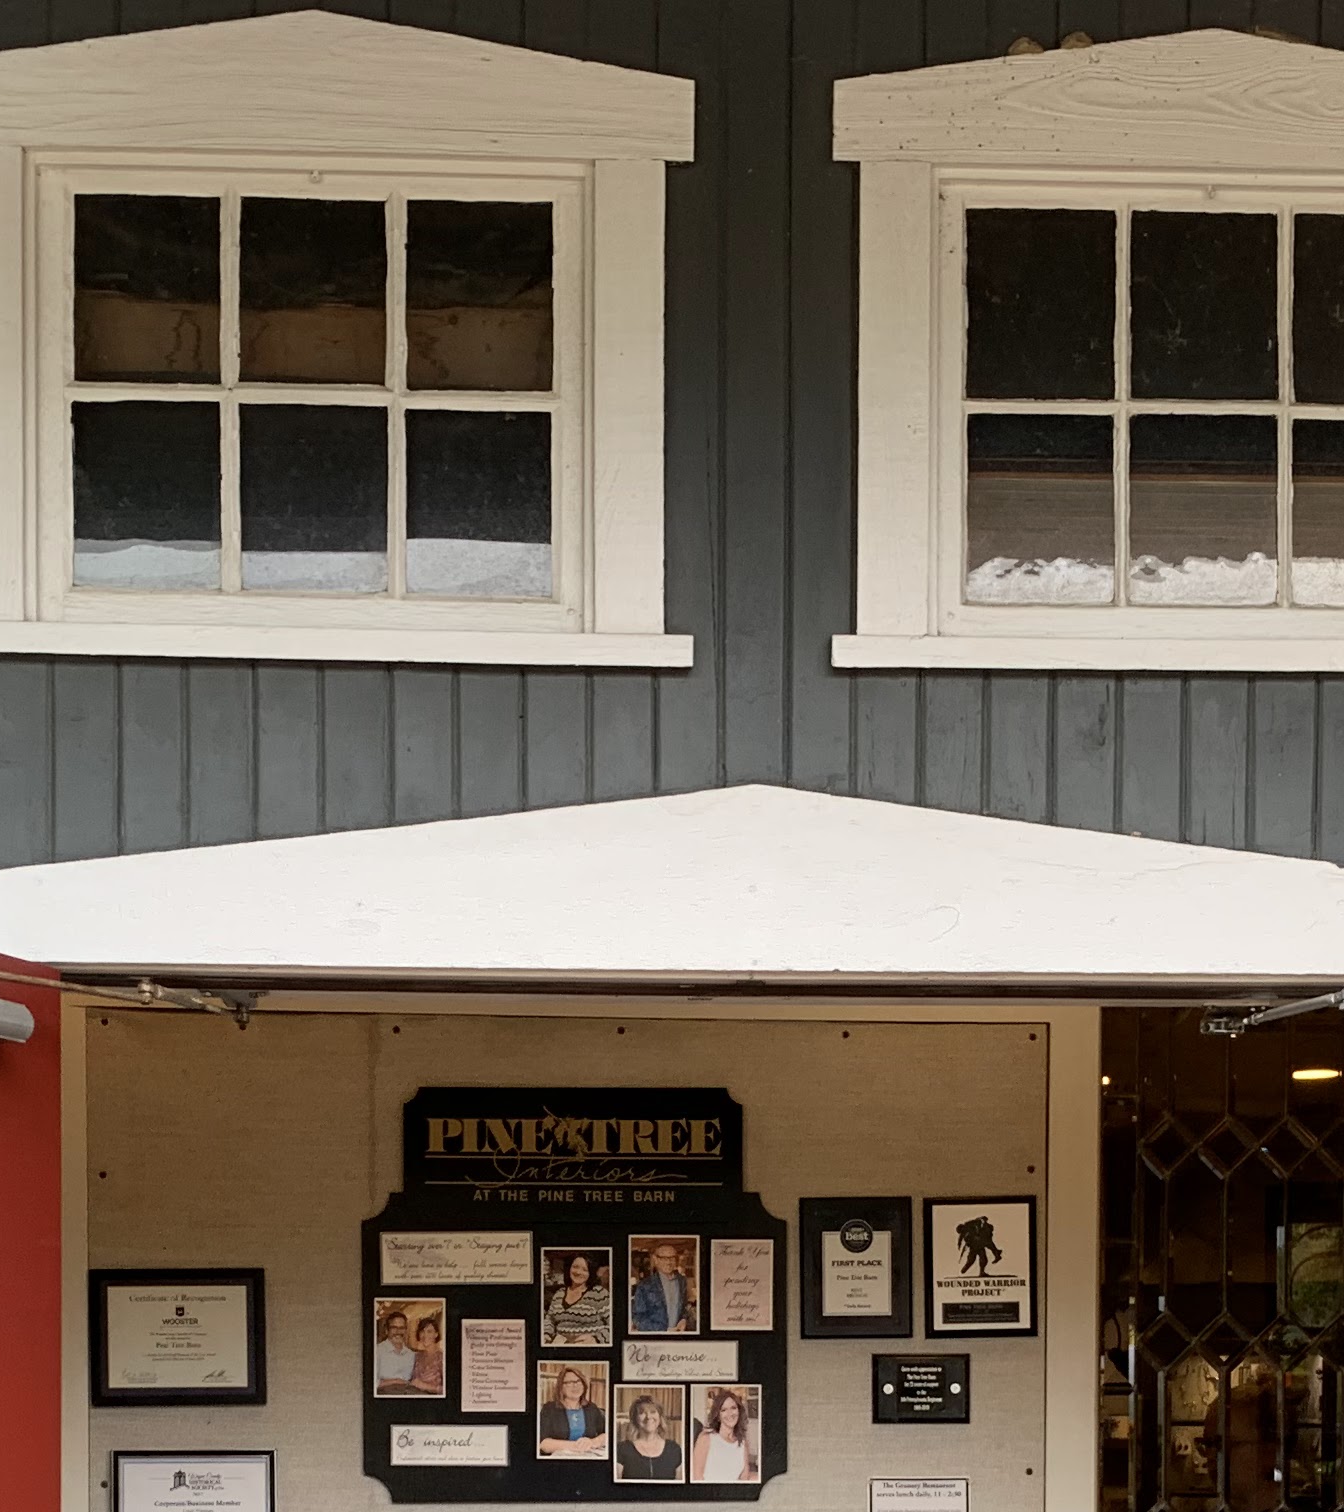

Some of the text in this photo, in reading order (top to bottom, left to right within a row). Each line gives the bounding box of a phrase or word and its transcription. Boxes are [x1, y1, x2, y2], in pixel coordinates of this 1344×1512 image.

[425, 1118, 723, 1156] PINE TREE
[465, 1144, 687, 1188] Interiors
[472, 1190, 675, 1202] AT THE PINE TREE BARN
[936, 1279, 1026, 1288] WOUNDED WARRIOR
[627, 1344, 651, 1362] We
[397, 1429, 414, 1448] Be
